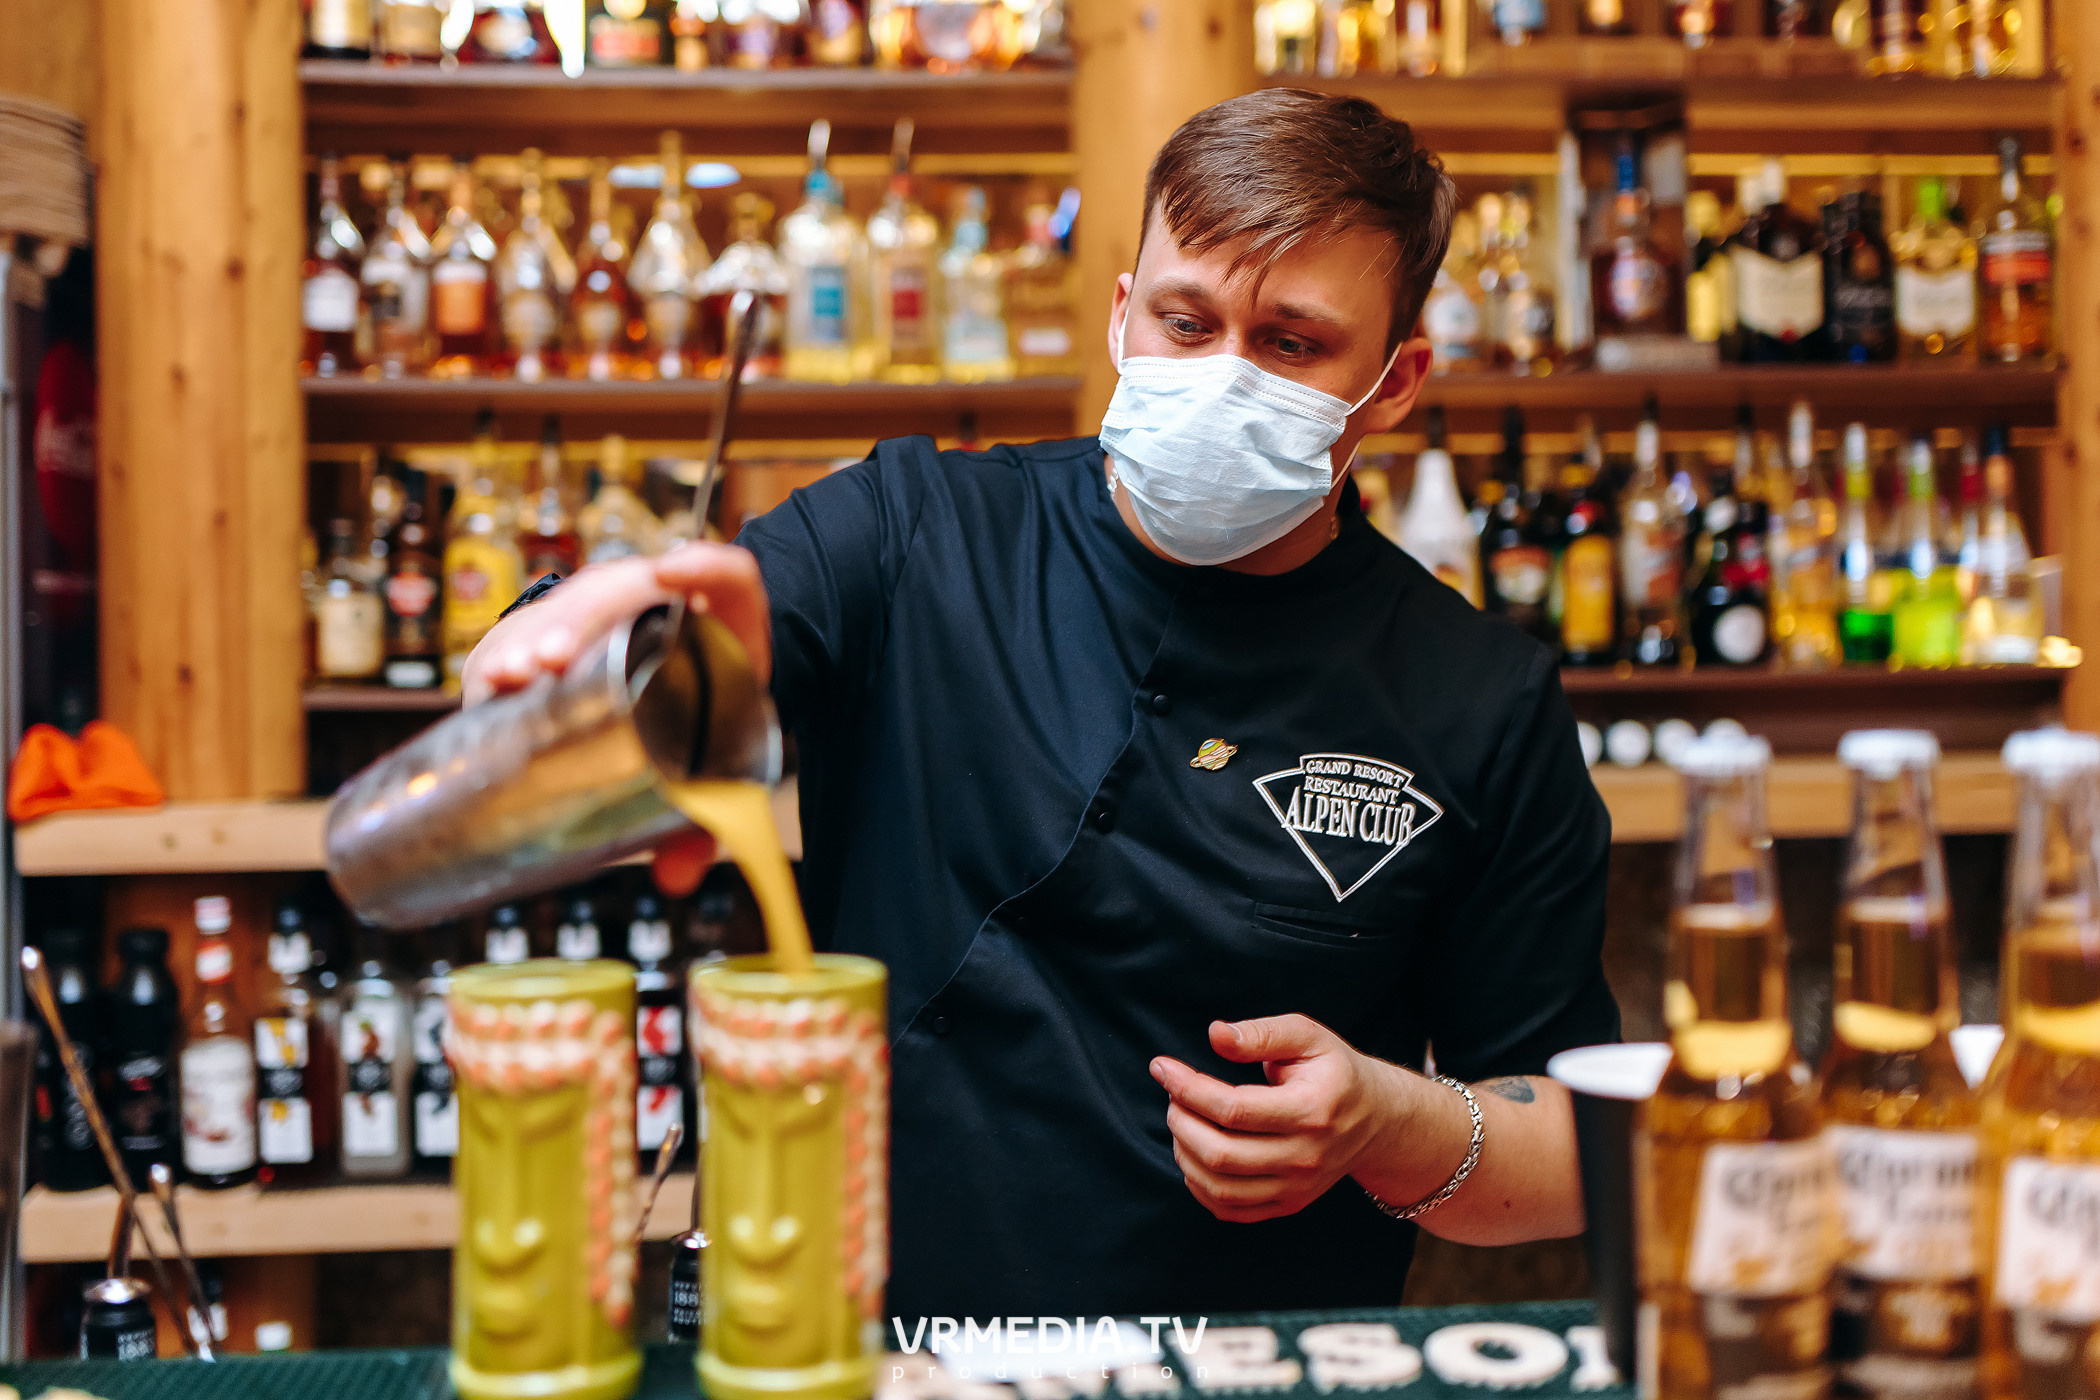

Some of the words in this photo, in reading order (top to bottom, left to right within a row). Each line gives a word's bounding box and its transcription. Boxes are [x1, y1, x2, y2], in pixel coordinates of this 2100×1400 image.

[1306, 760, 1352, 775] GRAND
[1353, 763, 1405, 788] RESORT
[1303, 775, 1401, 805] RESTAURANT
[1281, 785, 1360, 838] ALPEN
[1359, 802, 1416, 847] CLUB
